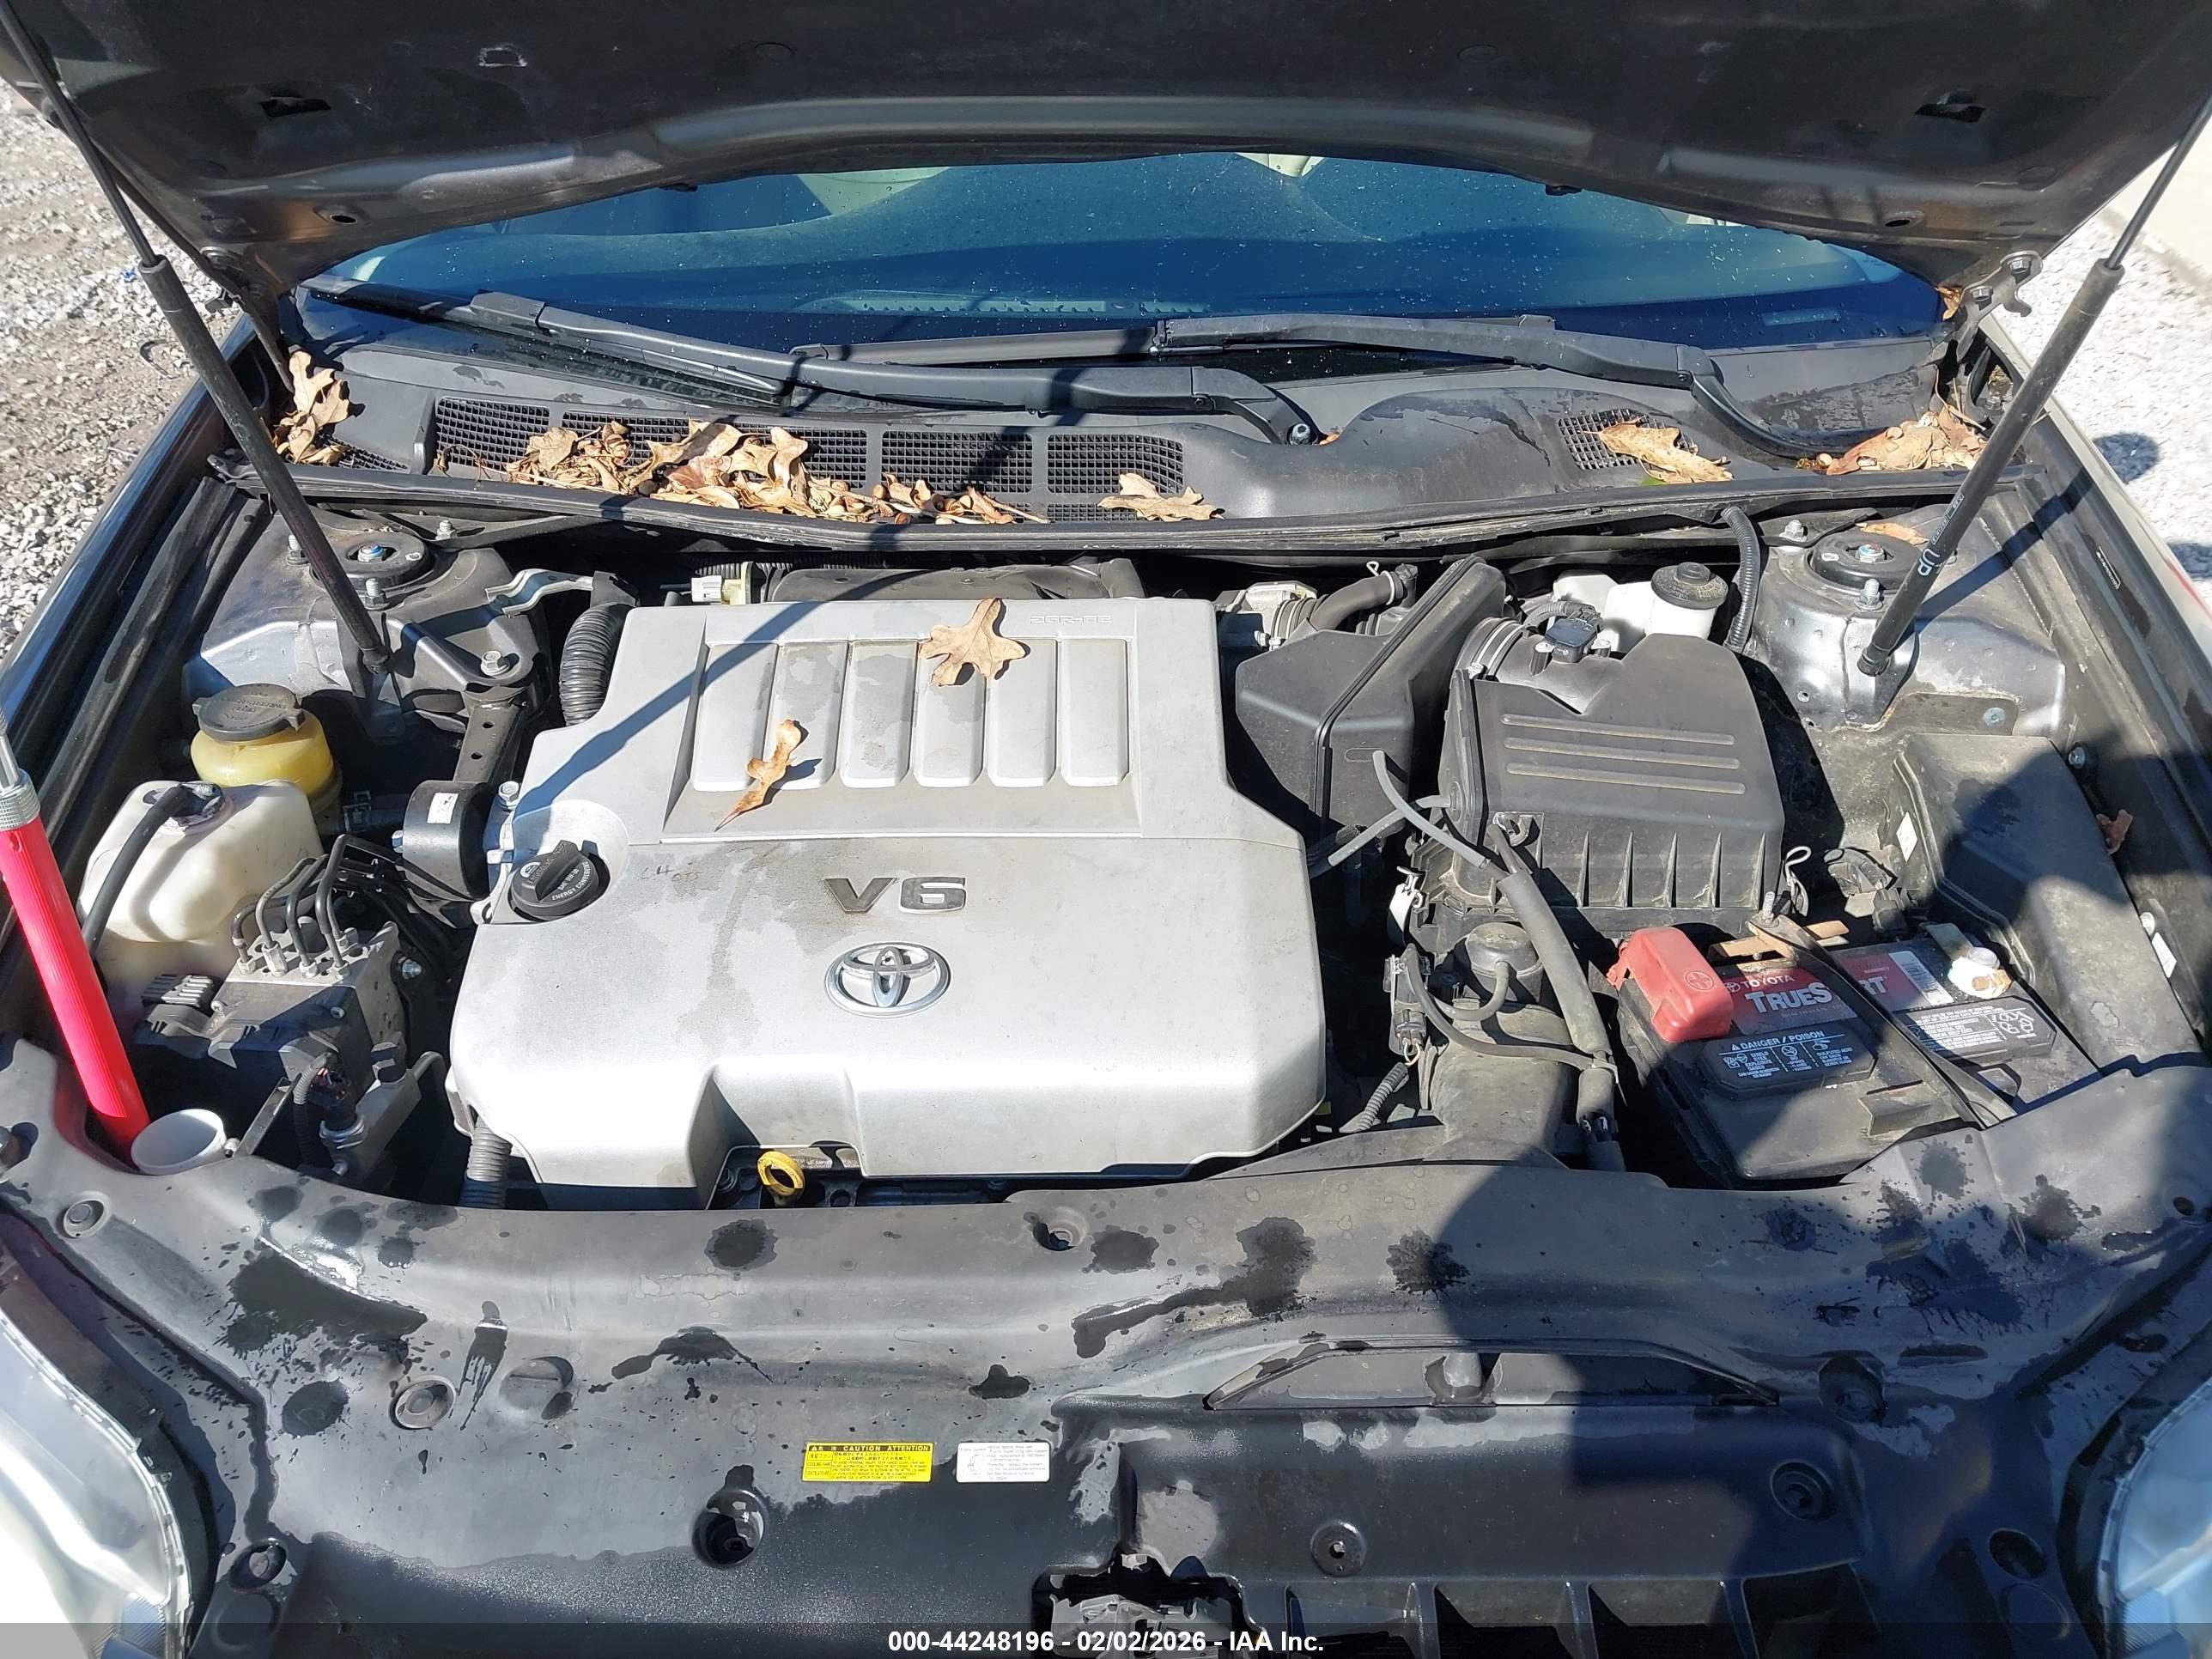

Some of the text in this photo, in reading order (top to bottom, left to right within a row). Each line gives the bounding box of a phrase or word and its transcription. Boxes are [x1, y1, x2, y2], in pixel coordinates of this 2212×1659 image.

[824, 877, 968, 914] V6
[1741, 975, 1795, 988] TOYOTA
[1741, 1037, 1781, 1050] DANGER
[1789, 1030, 1826, 1042] POISON
